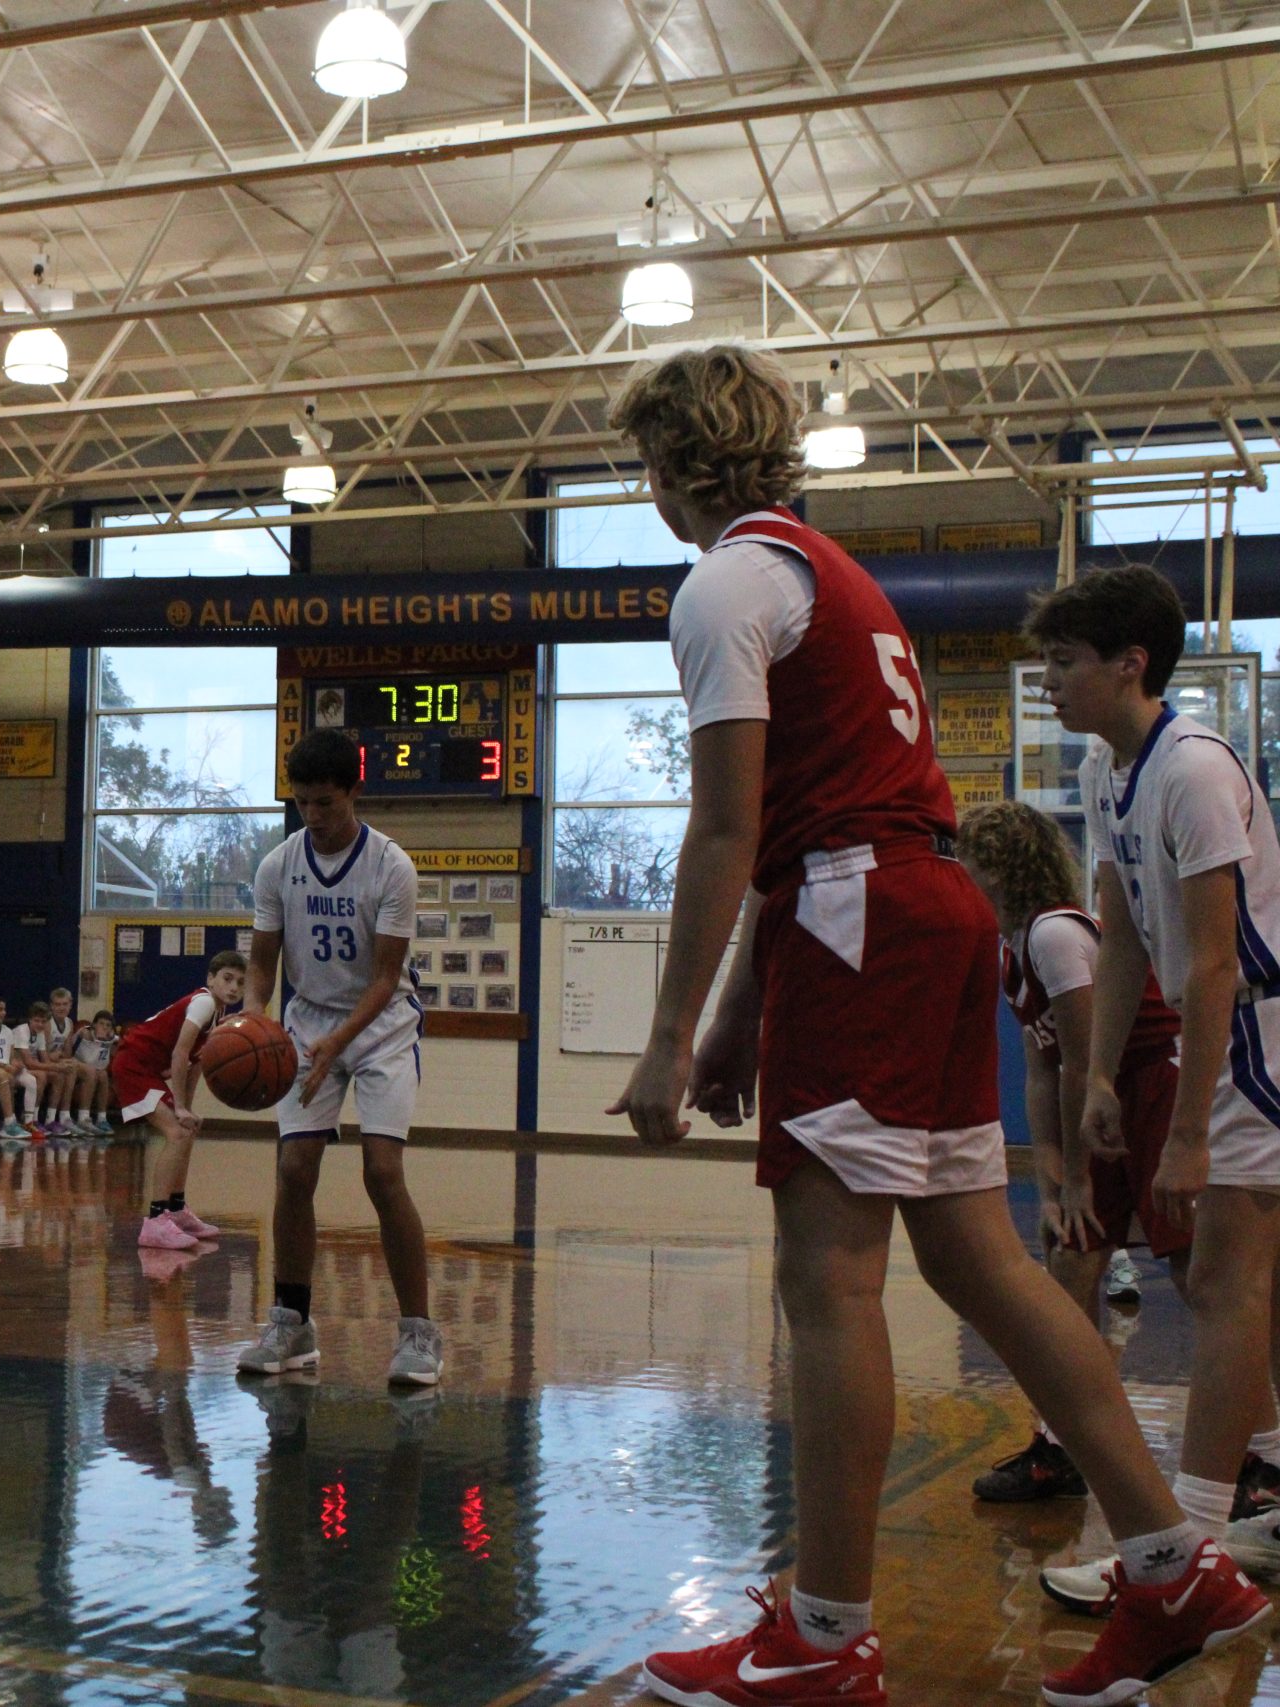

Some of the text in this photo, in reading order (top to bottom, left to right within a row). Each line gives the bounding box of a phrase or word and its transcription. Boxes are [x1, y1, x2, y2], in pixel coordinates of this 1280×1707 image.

[199, 597, 329, 627] ALAMO
[341, 593, 513, 626] HEIGHTS
[530, 587, 669, 620] MULES
[296, 644, 520, 668] WELLS FARGO
[379, 684, 459, 723] 7:30
[964, 707, 1001, 720] GRADE
[384, 732, 424, 743] PERIOD
[448, 724, 495, 739] GUEST
[513, 675, 532, 788] MULES
[939, 730, 1004, 742] BASKETBALL
[396, 744, 411, 766] 2
[480, 741, 501, 780] 3
[384, 768, 422, 780] BONUS
[411, 854, 514, 865] HALL OF HONOR
[306, 895, 356, 917] MULES
[311, 924, 357, 962] 33
[612, 926, 625, 939] PE
